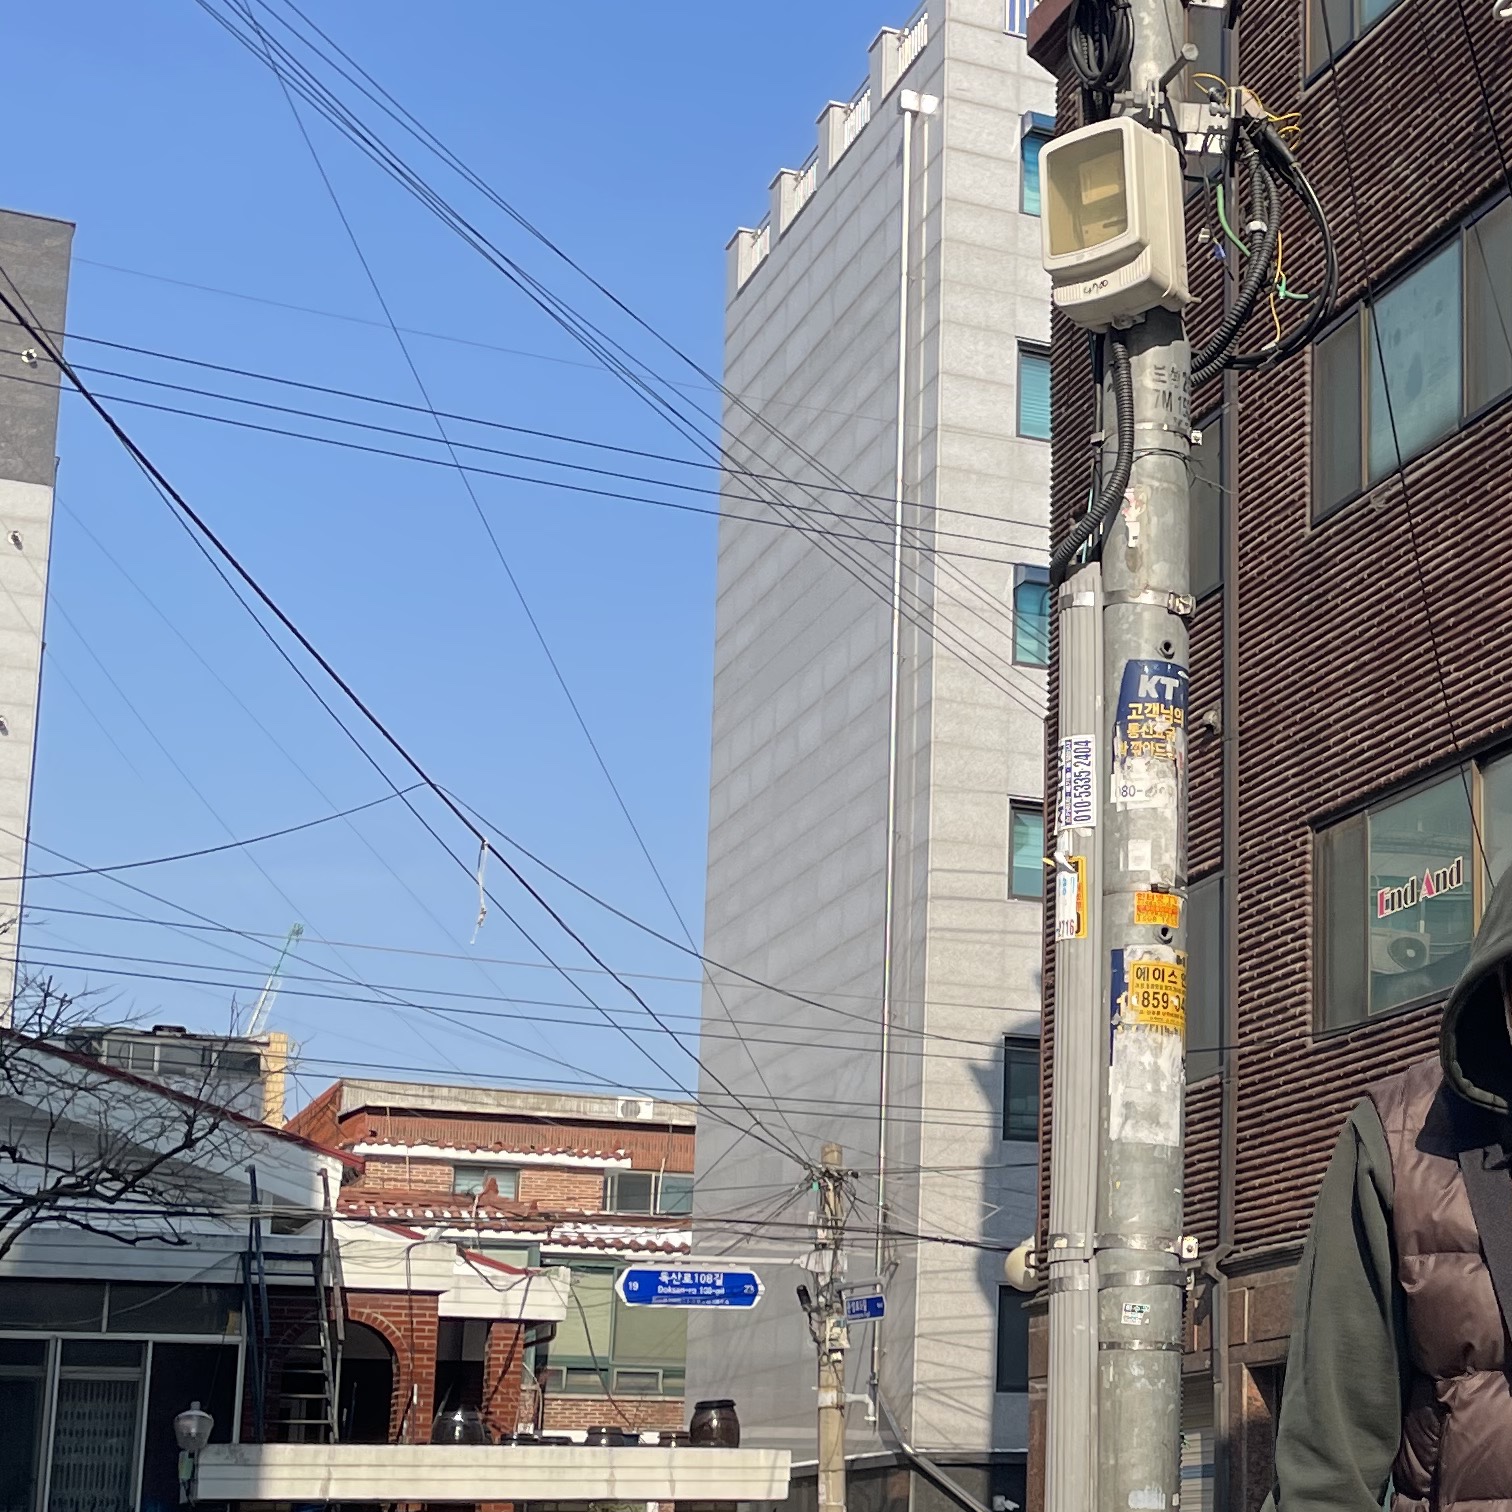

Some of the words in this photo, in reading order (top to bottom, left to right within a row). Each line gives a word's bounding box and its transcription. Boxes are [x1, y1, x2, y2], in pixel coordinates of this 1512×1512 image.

[1138, 674, 1180, 700] KT
[1127, 702, 1184, 728] 고객님의
[1377, 875, 1417, 918] End
[1419, 856, 1463, 902] And
